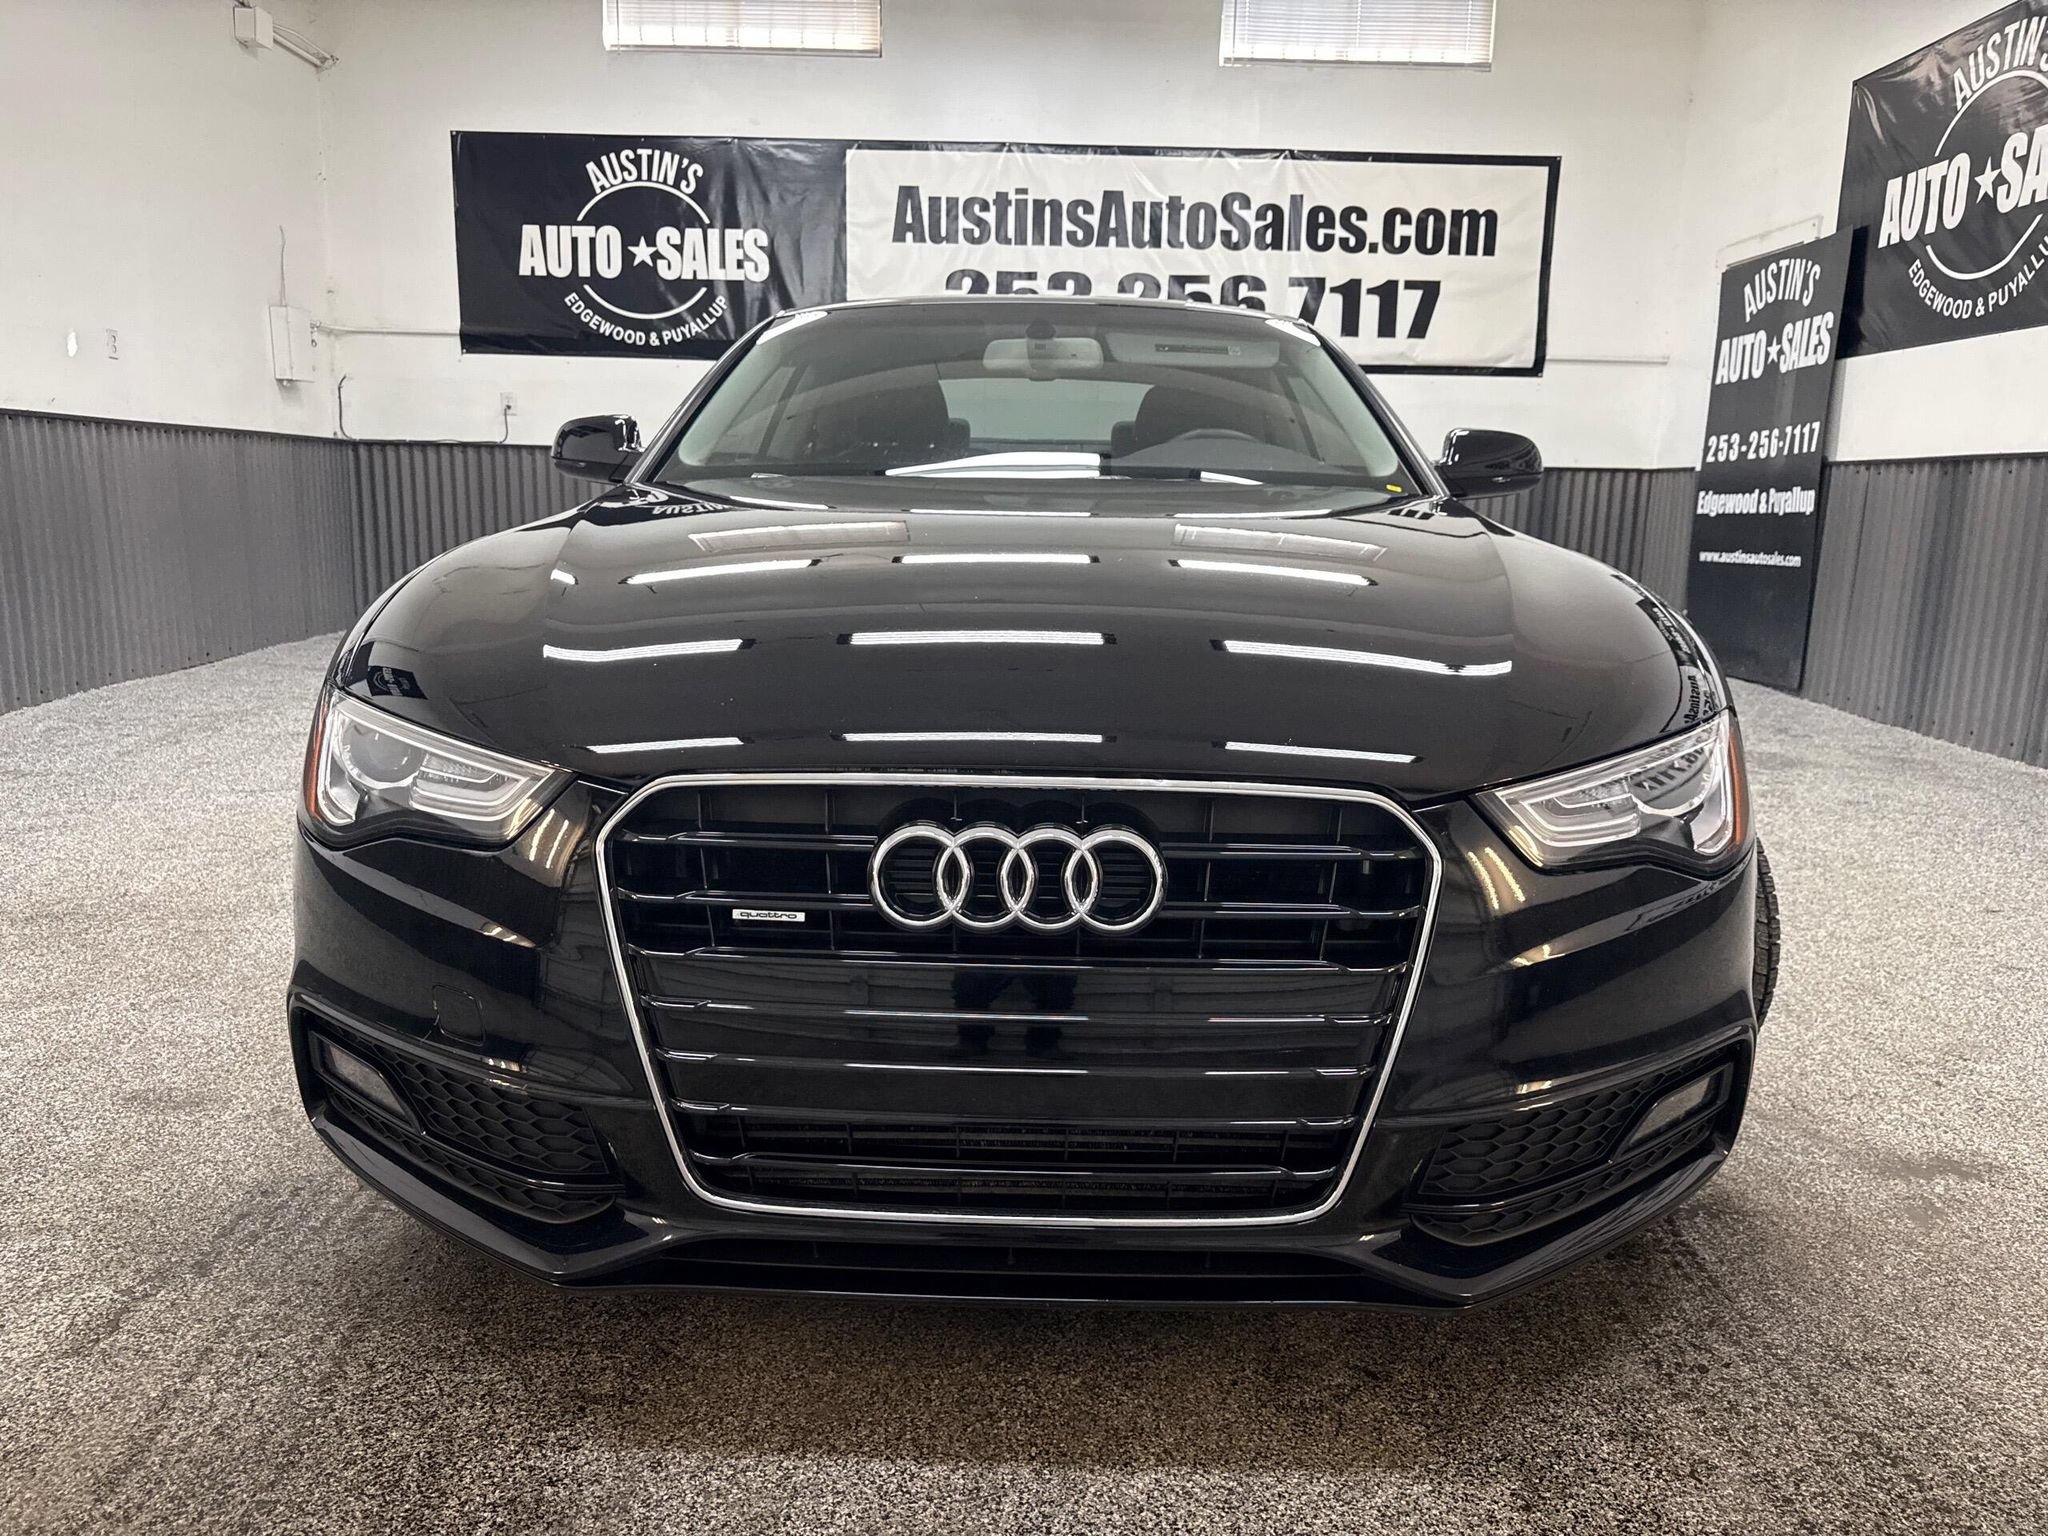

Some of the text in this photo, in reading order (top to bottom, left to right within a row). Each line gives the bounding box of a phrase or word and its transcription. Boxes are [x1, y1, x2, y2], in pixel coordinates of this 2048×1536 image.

[1953, 15, 2048, 111] AUSTIN
[585, 148, 704, 195] AUSTIN'S
[1878, 152, 1971, 249] AUTO
[891, 185, 1499, 257] AustinsAutoSales.com
[518, 224, 770, 283] AUTO SALES
[1908, 234, 2048, 320] EDGEWOOD & PUYALLU
[564, 292, 729, 347] EDGEWOOD & PUYALLUP
[1743, 257, 1821, 323] AUSTIN'S
[1714, 311, 1835, 386] AUTO SALES
[1705, 420, 1821, 463] 253-256-7117
[1696, 486, 1816, 518] Edgewood & Puyallup
[1699, 549, 1801, 568] www.austinsautosales.com
[740, 911, 798, 920] quattro
